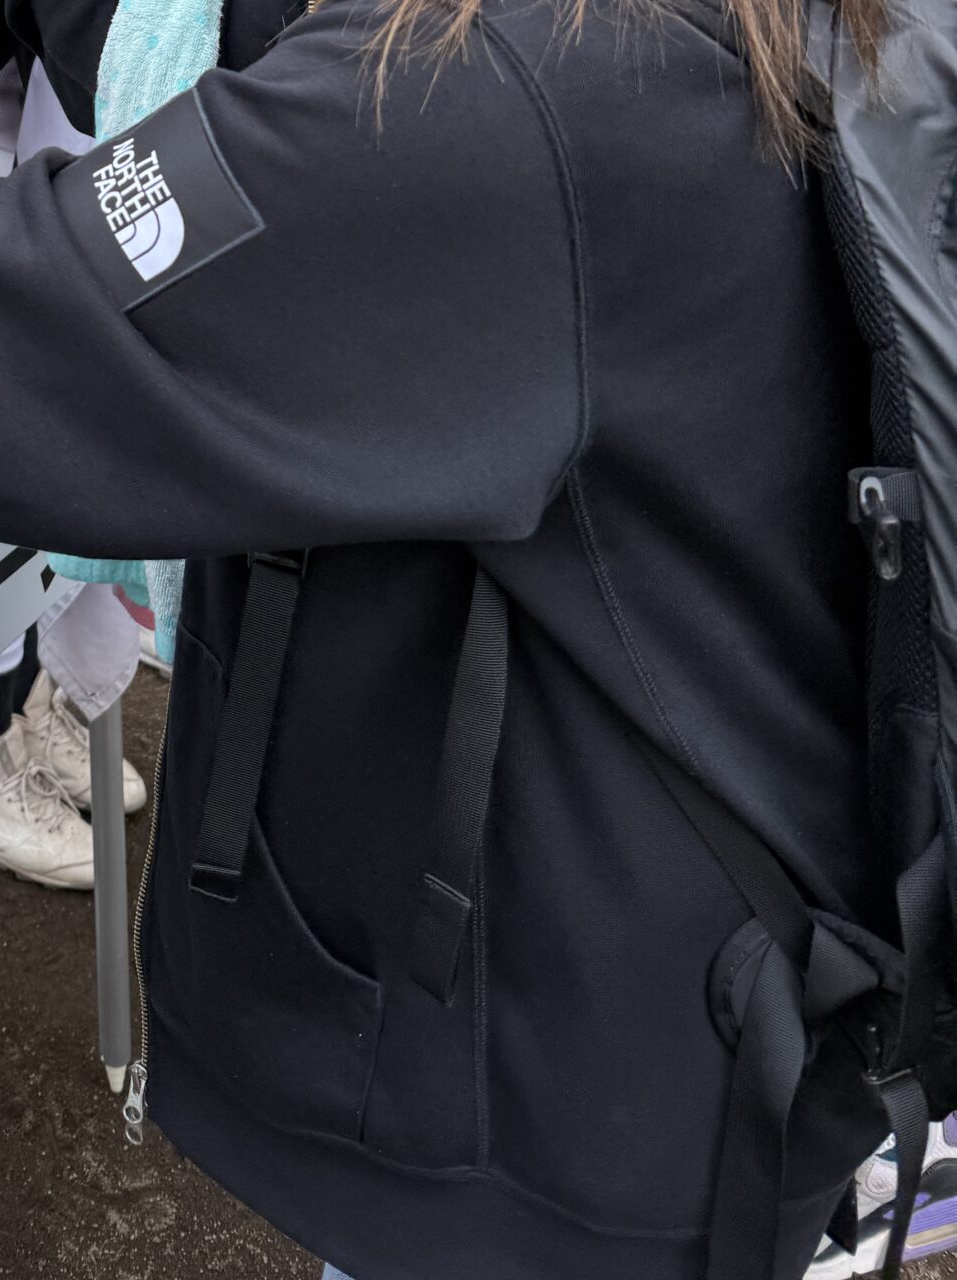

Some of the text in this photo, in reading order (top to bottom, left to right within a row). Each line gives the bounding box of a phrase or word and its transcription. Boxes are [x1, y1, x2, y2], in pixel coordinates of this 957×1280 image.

[92, 164, 132, 232] FACE
[112, 138, 151, 220] NORTH
[136, 150, 172, 207] THE
